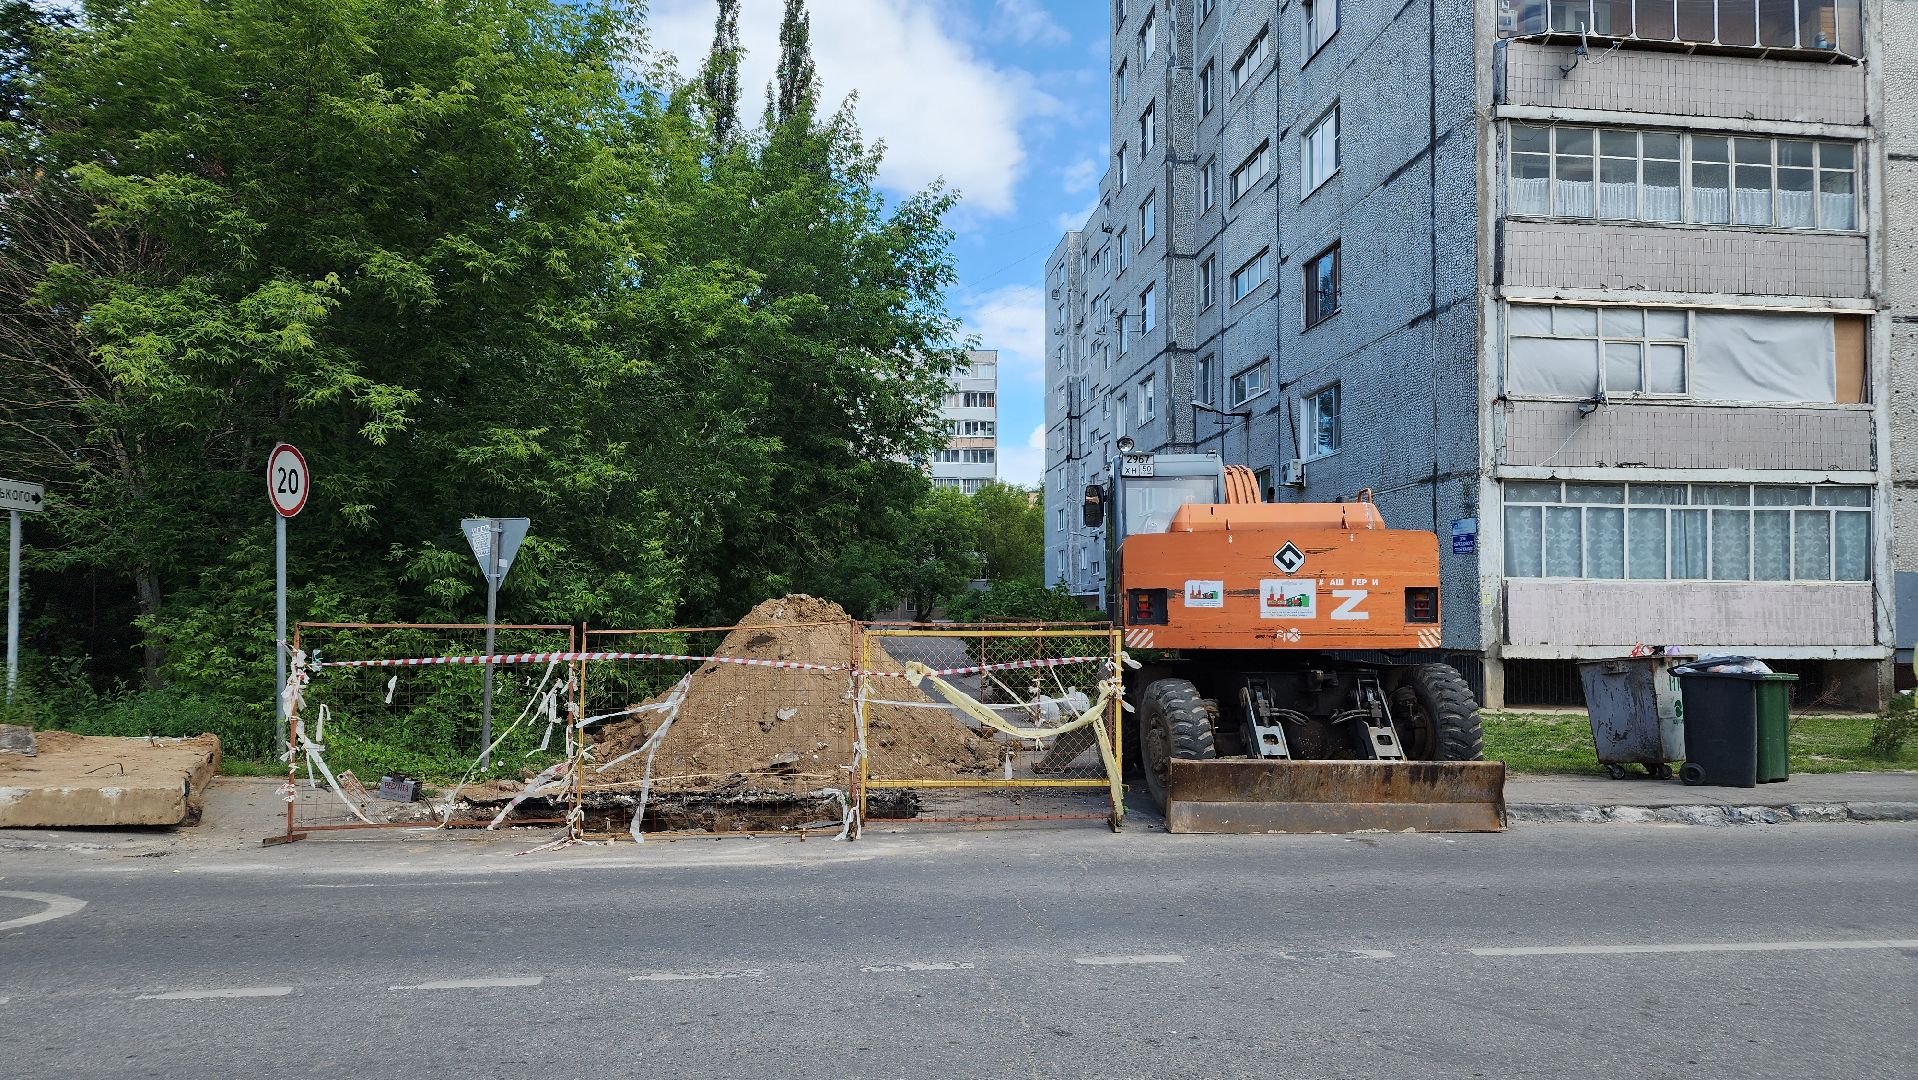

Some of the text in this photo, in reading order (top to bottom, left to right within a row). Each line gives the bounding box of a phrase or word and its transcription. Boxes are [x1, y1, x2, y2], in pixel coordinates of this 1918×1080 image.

[1126, 454, 1150, 464] 2967
[277, 466, 299, 495] 20
[1330, 589, 1369, 620] Z
